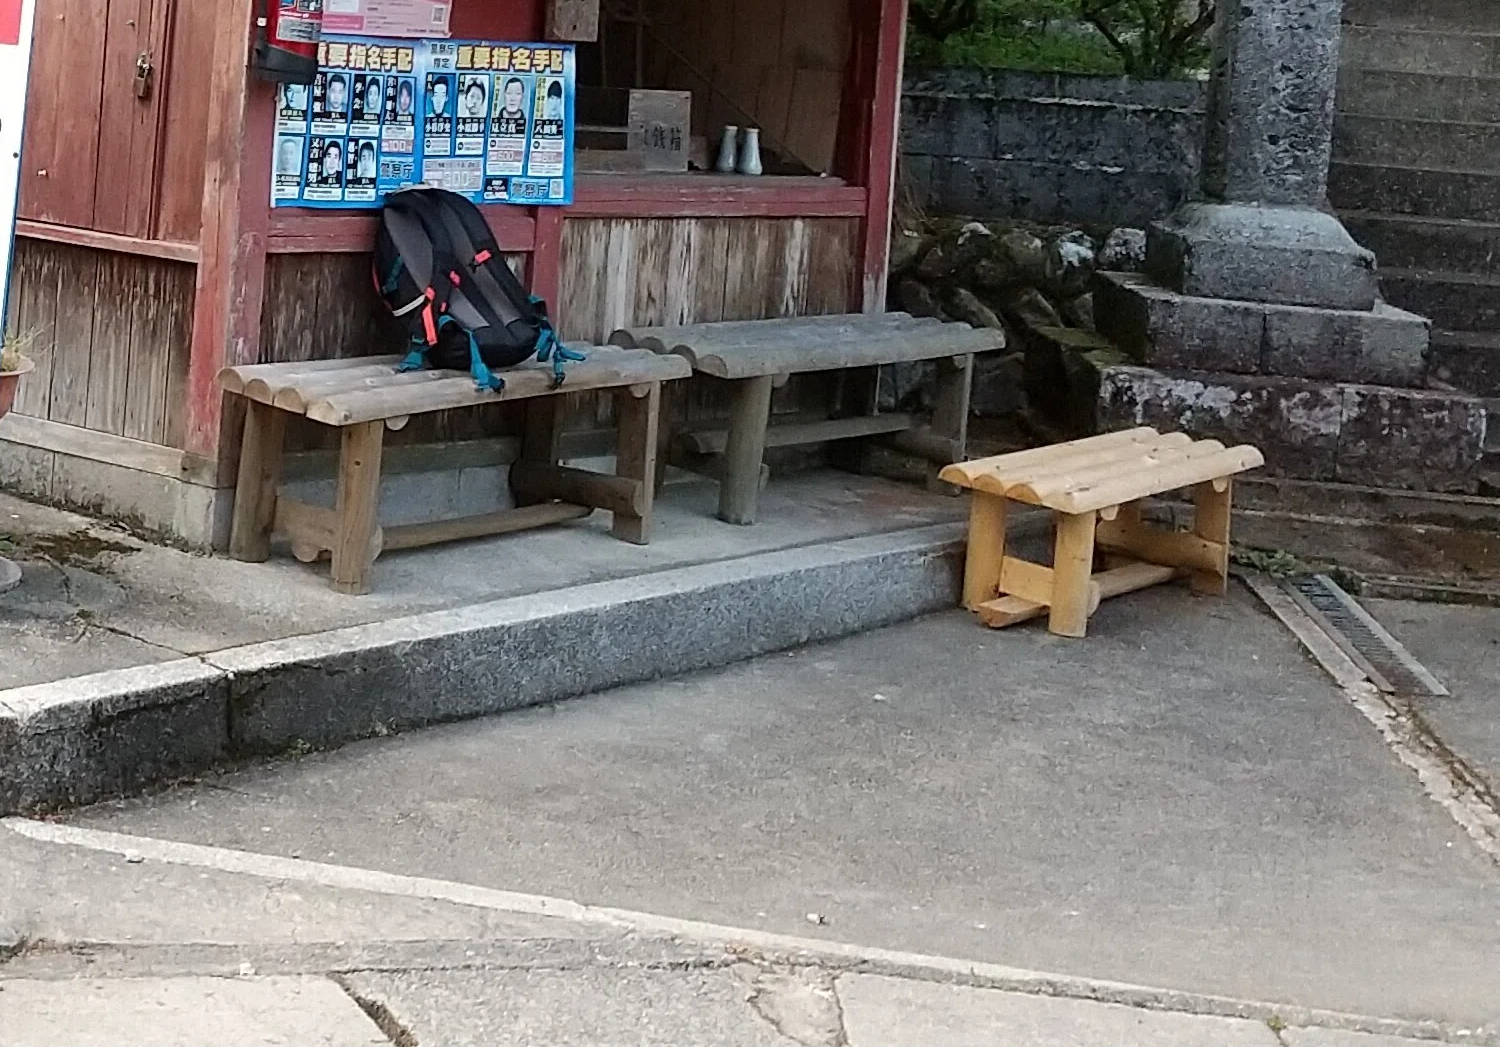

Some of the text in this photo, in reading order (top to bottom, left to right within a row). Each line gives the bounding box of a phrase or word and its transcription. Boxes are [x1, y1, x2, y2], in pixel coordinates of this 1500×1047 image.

[456, 44, 564, 74] 重要指名手配
